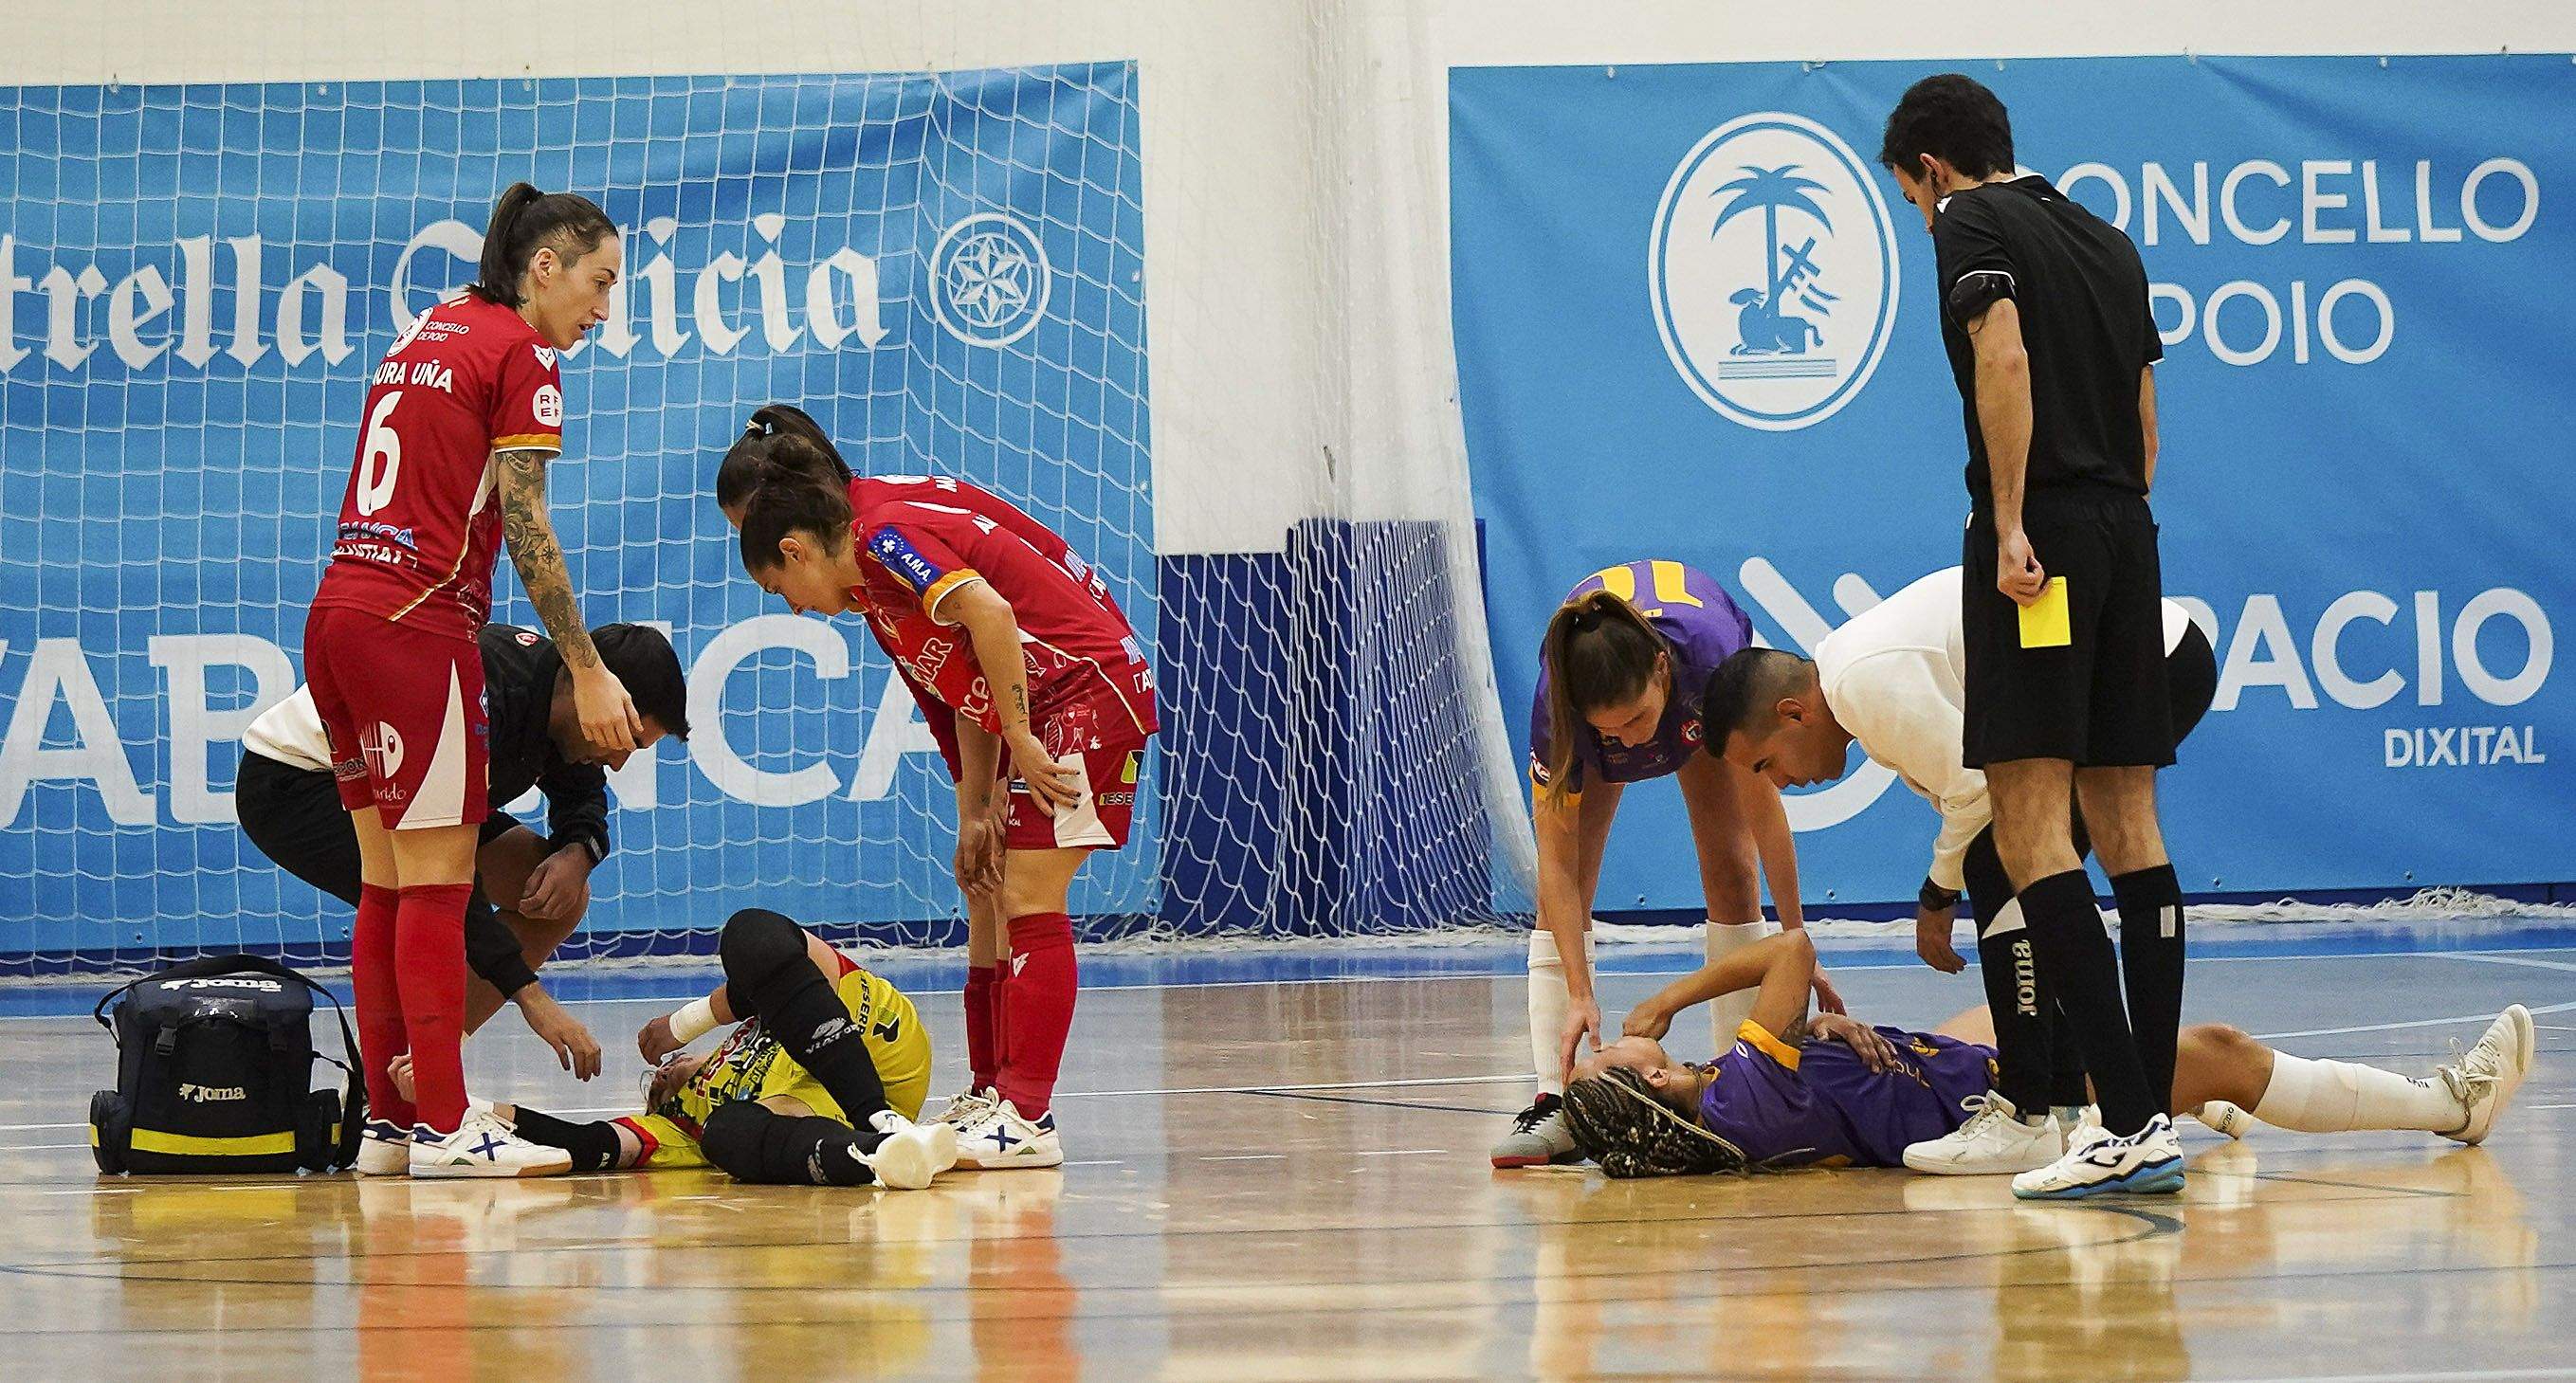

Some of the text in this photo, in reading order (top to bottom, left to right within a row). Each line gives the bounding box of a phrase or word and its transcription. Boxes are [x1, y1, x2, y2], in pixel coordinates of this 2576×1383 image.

[2015, 156, 2540, 246] ONCELLO
[392, 212, 889, 363] Glicia
[2150, 278, 2395, 367] POIO
[411, 359, 453, 394] UÑA
[355, 391, 404, 518] 6
[2384, 725, 2548, 769] DIXITAL
